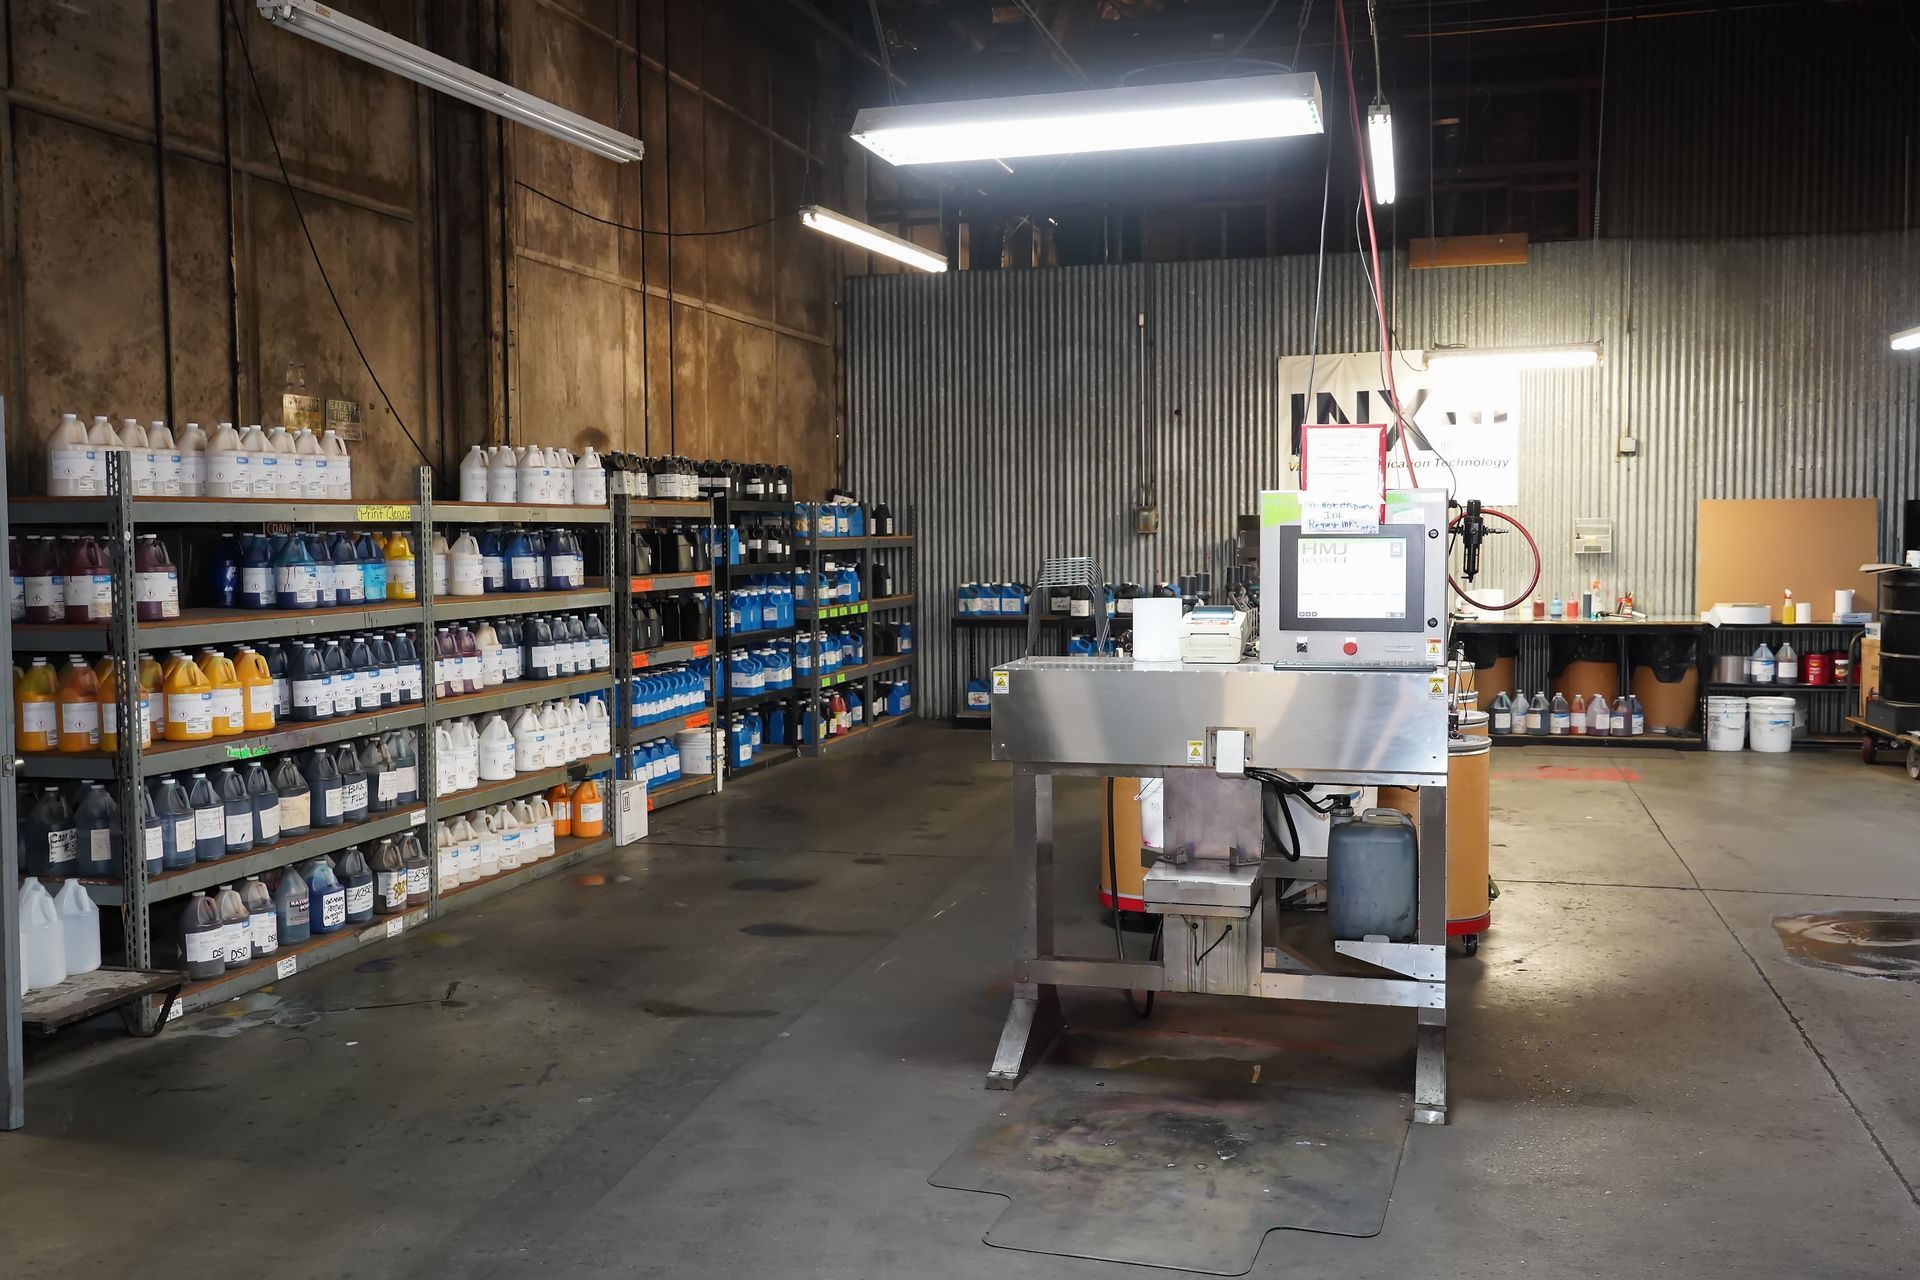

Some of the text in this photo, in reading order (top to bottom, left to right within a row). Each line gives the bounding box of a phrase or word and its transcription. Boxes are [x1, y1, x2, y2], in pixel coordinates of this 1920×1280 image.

[328, 400, 358, 414] SAFETY
[333, 409, 352, 422] FIRST
[1291, 389, 1432, 455] INX
[1434, 457, 1510, 470] Technology
[358, 507, 383, 520] Print
[1302, 542, 1348, 555] HMJ
[231, 946, 248, 960] DSD
